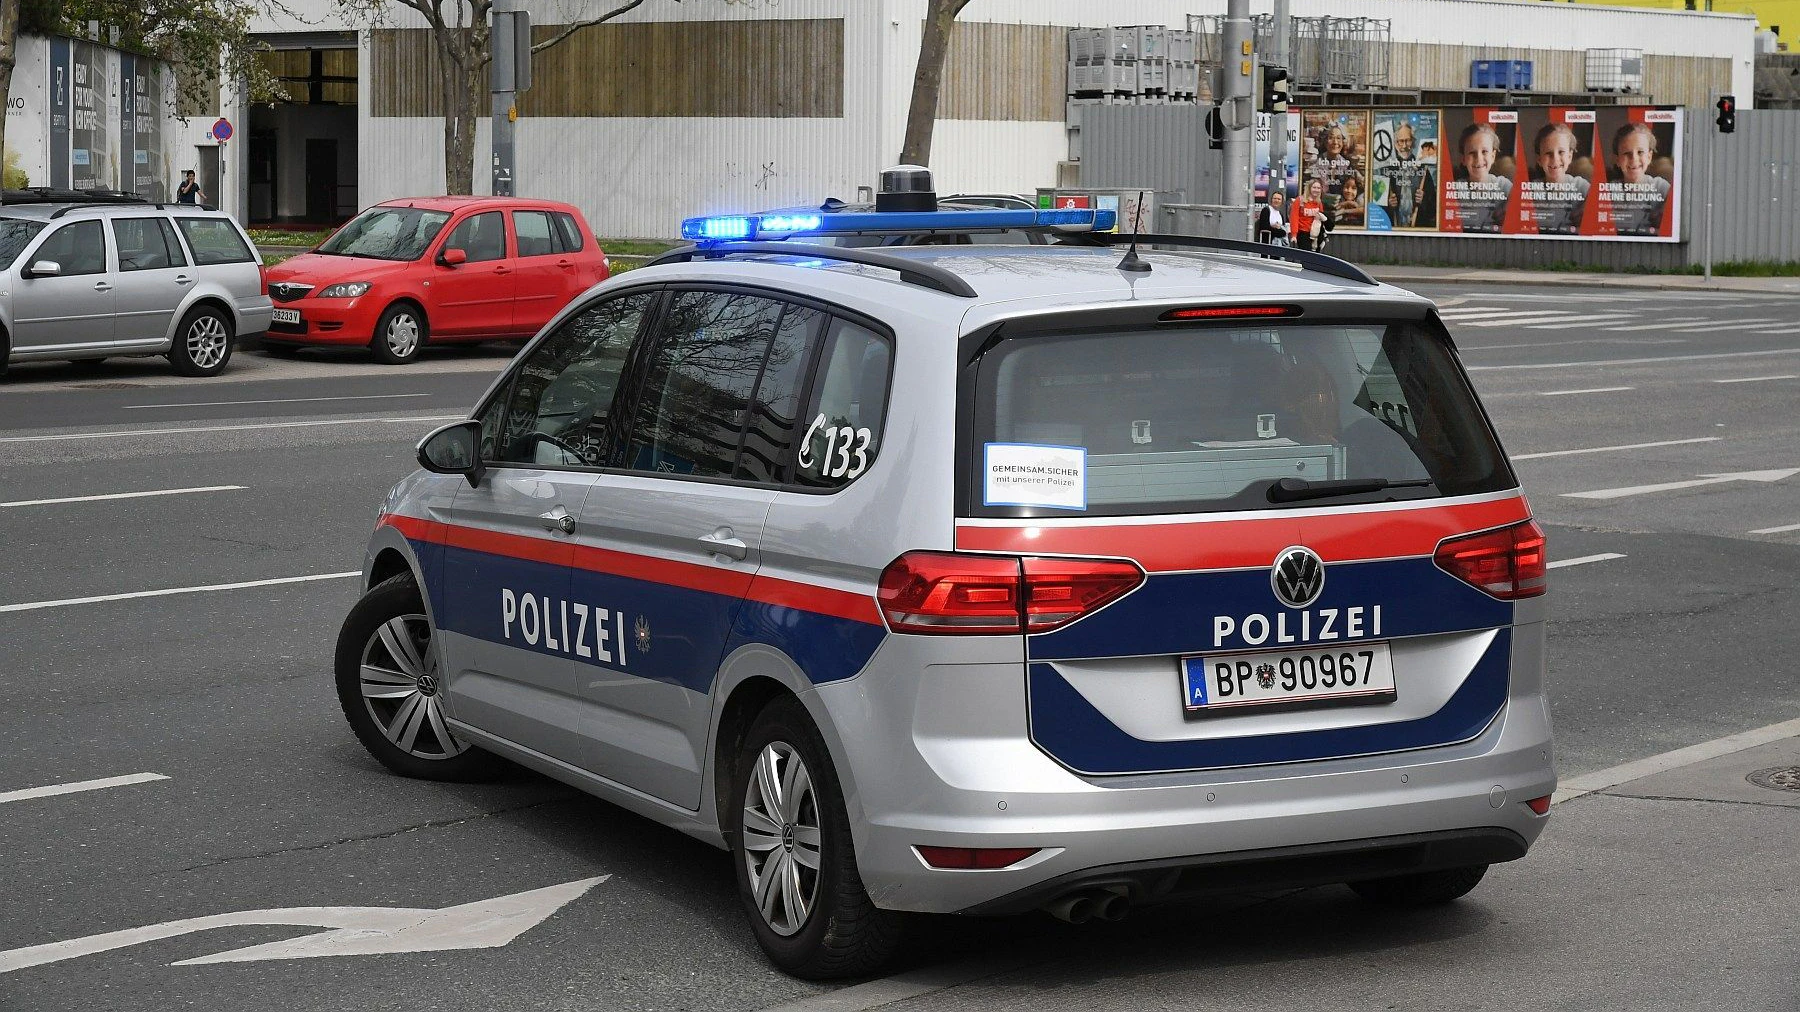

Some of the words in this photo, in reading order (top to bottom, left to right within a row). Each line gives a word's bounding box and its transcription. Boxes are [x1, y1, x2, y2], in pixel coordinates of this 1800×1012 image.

[1318, 158, 1329, 166] Ich
[1331, 159, 1350, 168] gebe
[1402, 159, 1422, 169] gebe
[1446, 182, 1468, 190] DEINE
[1470, 182, 1500, 190] SPENDE.
[1522, 182, 1544, 190] DEINE
[1546, 182, 1578, 191] SPENDE.
[1599, 182, 1623, 192] DEINE
[1624, 183, 1657, 192] SPENDE.
[1446, 191, 1470, 200] MEINE
[1471, 191, 1507, 200] BILDUNG.
[1522, 192, 1546, 200] MEINE
[1548, 192, 1584, 200] BILDUNG.
[1599, 193, 1624, 201] MEINE
[1626, 193, 1664, 202] BILDUNG.
[822, 426, 871, 478] 133
[992, 465, 1078, 476] GEMEINSAM.SICHER
[1048, 478, 1074, 486] Polizei
[502, 588, 626, 666] POLIZEI
[1213, 604, 1381, 646] POLIZEI
[1215, 660, 1252, 697] BP
[1279, 650, 1374, 691] 90967
[1194, 687, 1202, 699] A
